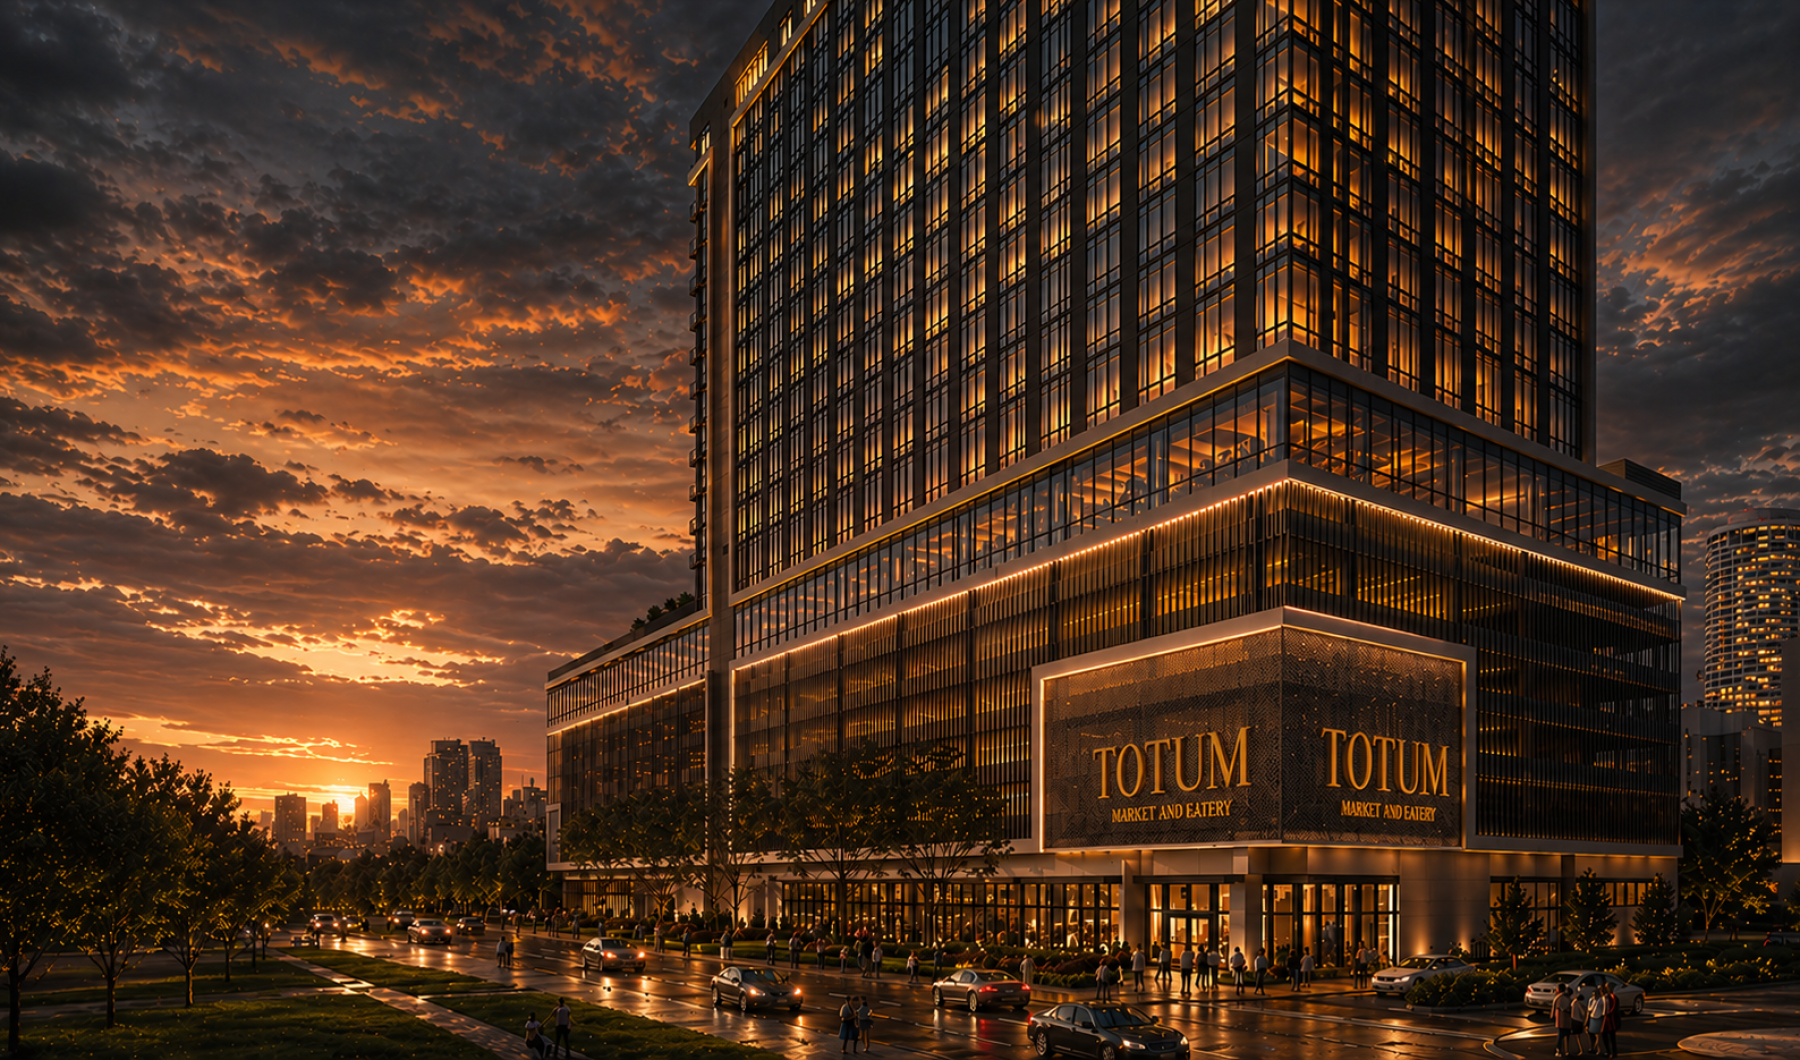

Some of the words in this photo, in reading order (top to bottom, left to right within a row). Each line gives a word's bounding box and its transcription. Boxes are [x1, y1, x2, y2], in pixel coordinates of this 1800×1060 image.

[1093, 726, 1252, 799] TOTUM
[1321, 727, 1450, 797] TOTUM
[1112, 806, 1156, 823] MARKET
[1159, 804, 1183, 820] AND
[1186, 800, 1233, 818] EATERY
[1341, 800, 1381, 818] MARKET
[1383, 804, 1403, 820] AND
[1404, 805, 1437, 822] EATERY
